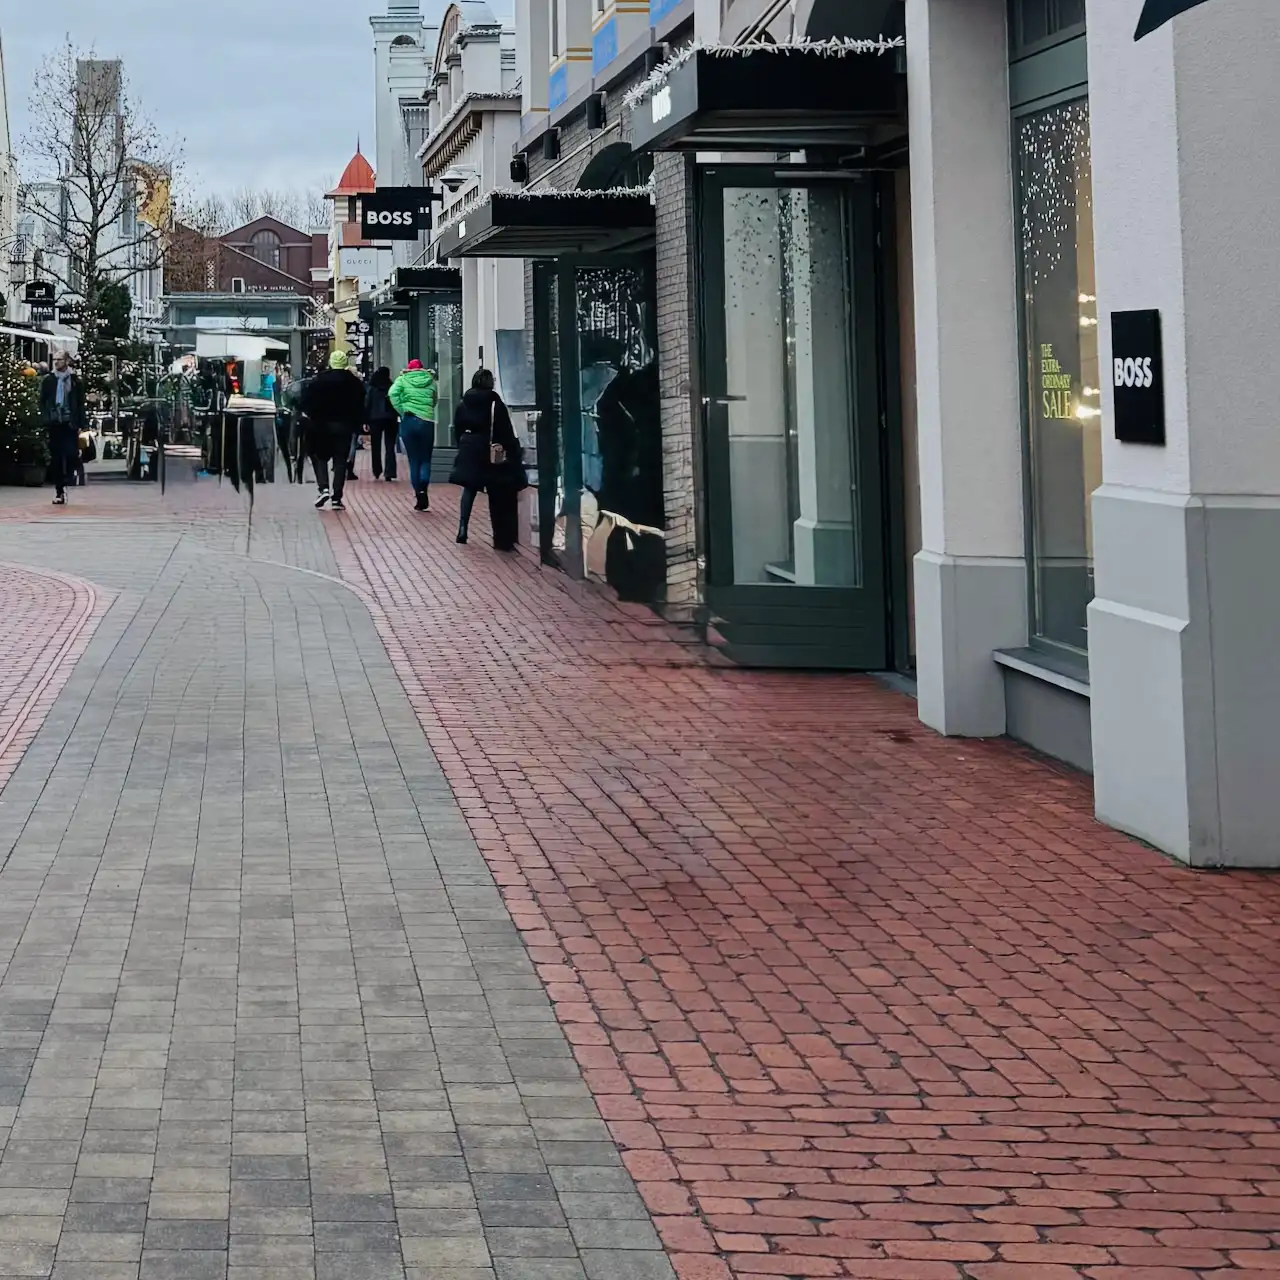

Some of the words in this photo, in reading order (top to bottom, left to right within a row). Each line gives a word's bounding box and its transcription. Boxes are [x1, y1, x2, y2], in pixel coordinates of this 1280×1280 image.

[366, 210, 413, 225] BOSS
[1040, 343, 1053, 357] THE
[1113, 357, 1153, 388] BOSS
[1043, 390, 1072, 419] SALE
